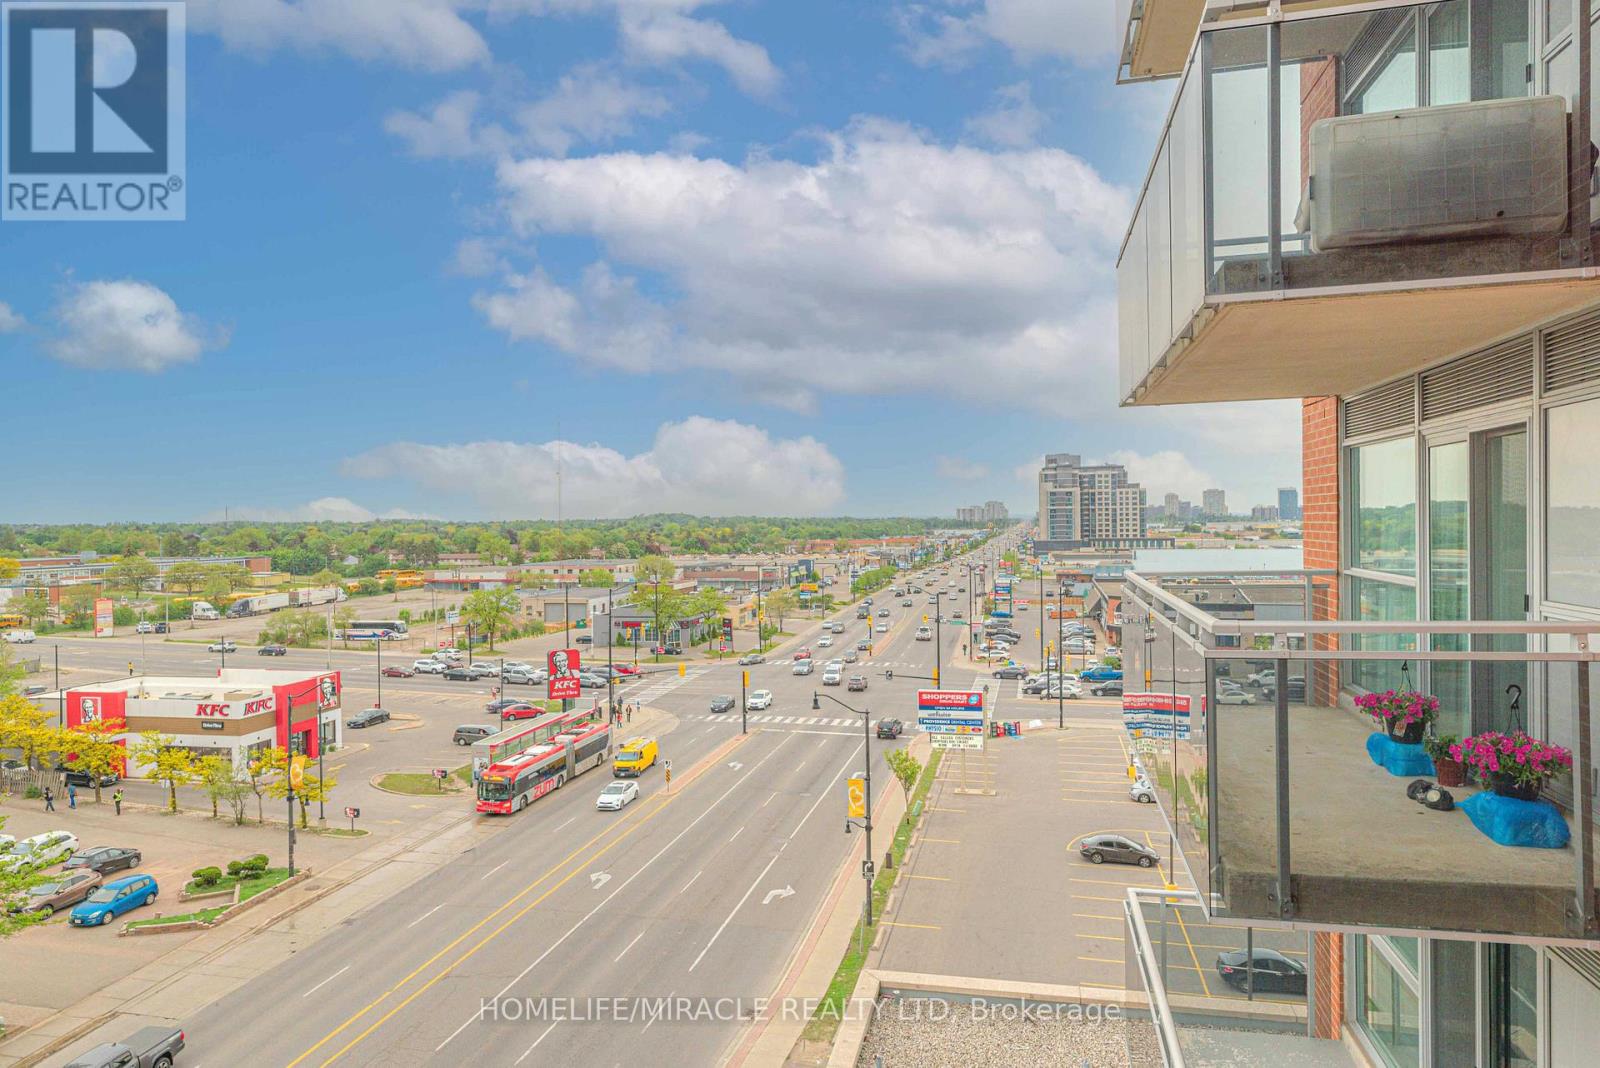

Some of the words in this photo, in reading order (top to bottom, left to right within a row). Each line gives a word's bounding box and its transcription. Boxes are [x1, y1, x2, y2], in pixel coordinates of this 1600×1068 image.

[554, 680, 577, 690] KFC
[195, 703, 230, 717] KFC
[243, 697, 273, 716] KFC
